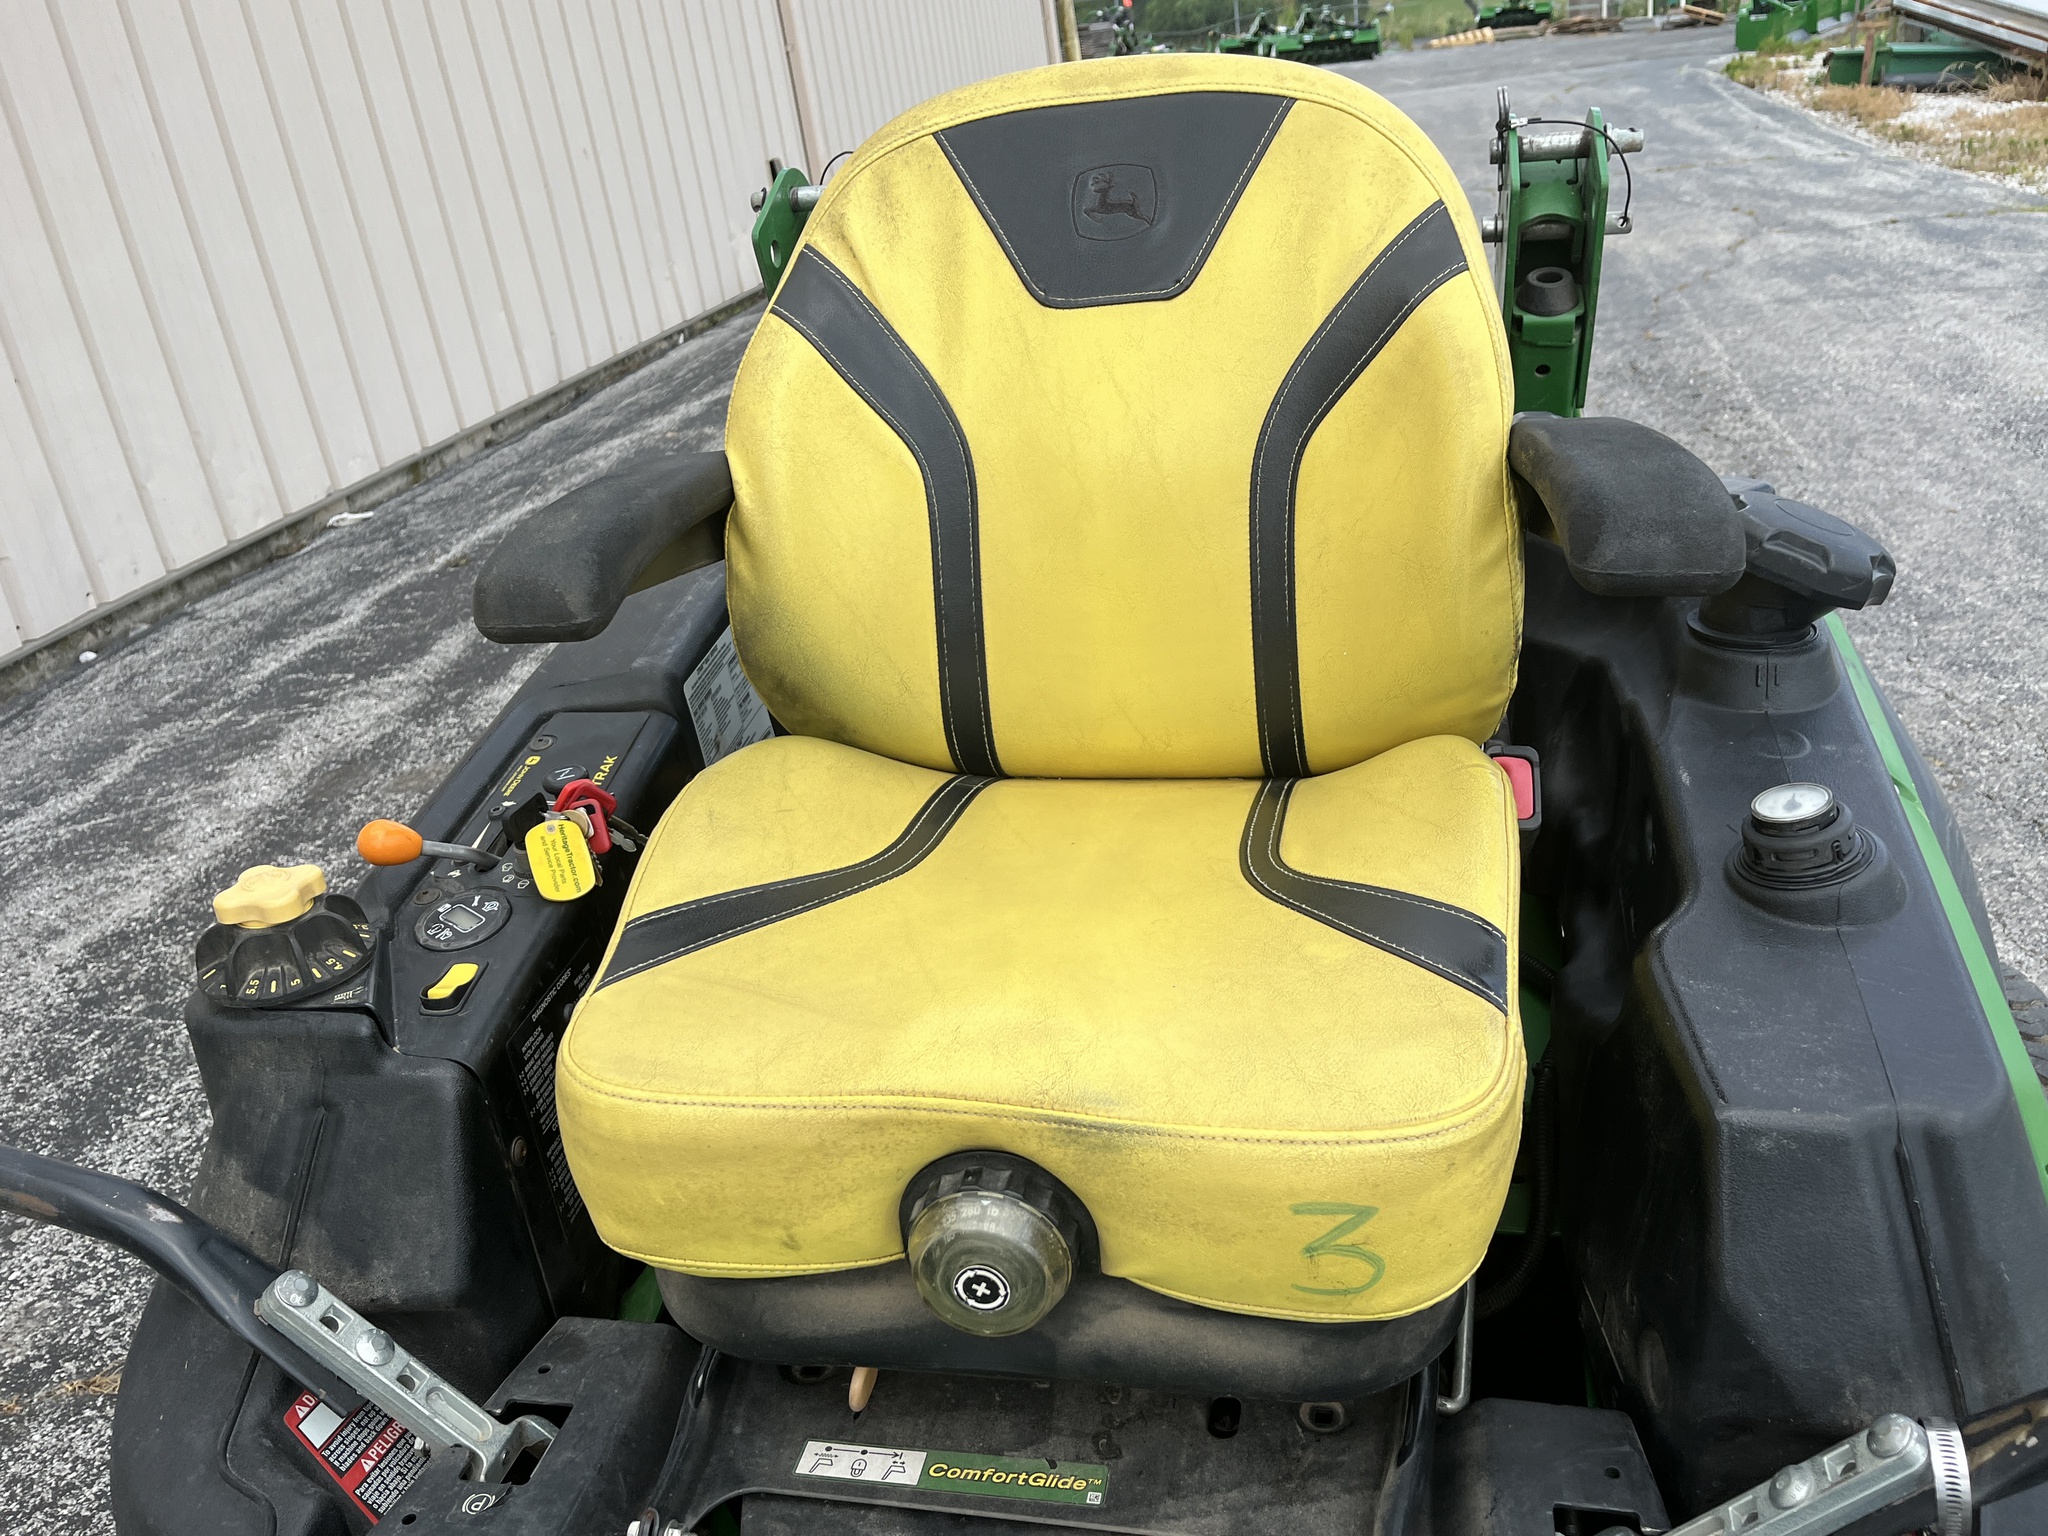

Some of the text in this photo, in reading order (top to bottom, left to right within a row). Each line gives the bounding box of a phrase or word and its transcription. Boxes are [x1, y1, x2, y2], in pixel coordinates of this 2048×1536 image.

[592, 756, 618, 785] TRAK
[540, 836, 560, 892] and Service Provider
[550, 838, 567, 884] Your Local Parts
[558, 824, 581, 893] HeritageTractor.com
[290, 978, 301, 987] 5
[325, 957, 343, 971] 4.5
[245, 979, 260, 995] 5.5
[532, 987, 557, 1022] DIAGNOSTIC
[521, 1025, 542, 1054] INTERLOCK
[524, 1032, 544, 1061] VIOLATIONS
[1289, 1202, 1386, 1296] 3
[321, 1449, 331, 1457] To
[328, 1435, 343, 1451] avoid
[340, 1422, 356, 1437] injury
[352, 1410, 366, 1423] from
[328, 1444, 346, 1462] across
[344, 1427, 363, 1445] slopes,
[360, 1416, 370, 1427] not
[368, 1410, 376, 1418] up
[338, 1441, 358, 1462] machine
[354, 1428, 370, 1442] stops
[368, 1414, 382, 1430] going
[339, 1417, 389, 1472] blades and back down
[368, 1421, 406, 1462] PELIGR
[355, 1482, 369, 1496] Para
[366, 1468, 381, 1484] evitar
[378, 1448, 398, 1469] lesiones
[396, 1438, 406, 1449] que
[362, 1437, 417, 1500] causadas por volcadura de
[367, 1490, 380, 1504] viaje
[378, 1483, 386, 1492] en
[382, 1465, 401, 1484] sentido
[374, 1489, 390, 1505] hacia
[400, 1466, 409, 1475] Si
[376, 1489, 399, 1513] subiendo
[397, 1479, 408, 1491] una
